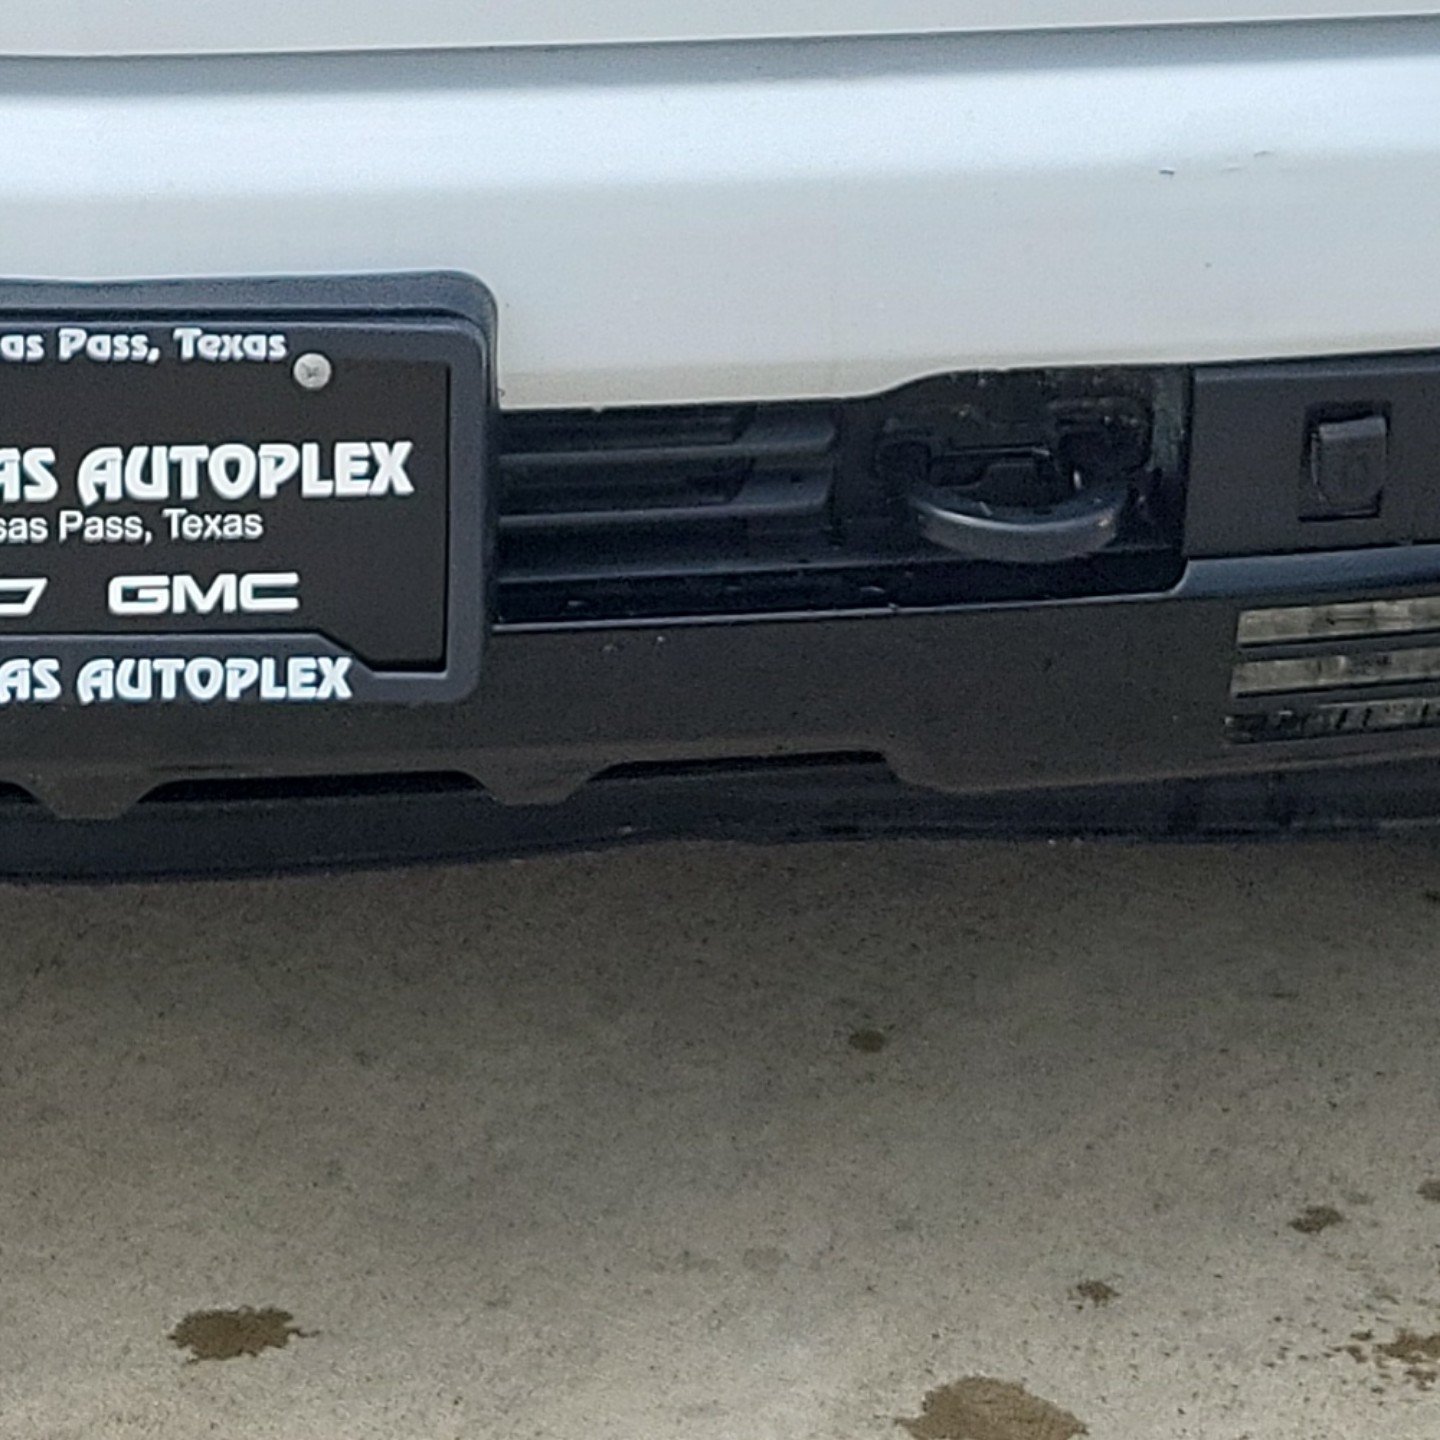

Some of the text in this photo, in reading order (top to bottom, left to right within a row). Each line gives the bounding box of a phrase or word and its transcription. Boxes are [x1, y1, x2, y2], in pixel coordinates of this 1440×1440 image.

[57, 327, 162, 365] Pass,
[173, 326, 288, 360] Texas
[77, 441, 414, 507] AUTOPLEX
[58, 509, 153, 546] Pass,
[162, 508, 265, 540] Texas
[107, 572, 300, 616] GMC
[77, 656, 353, 703] AUTOPLEX
